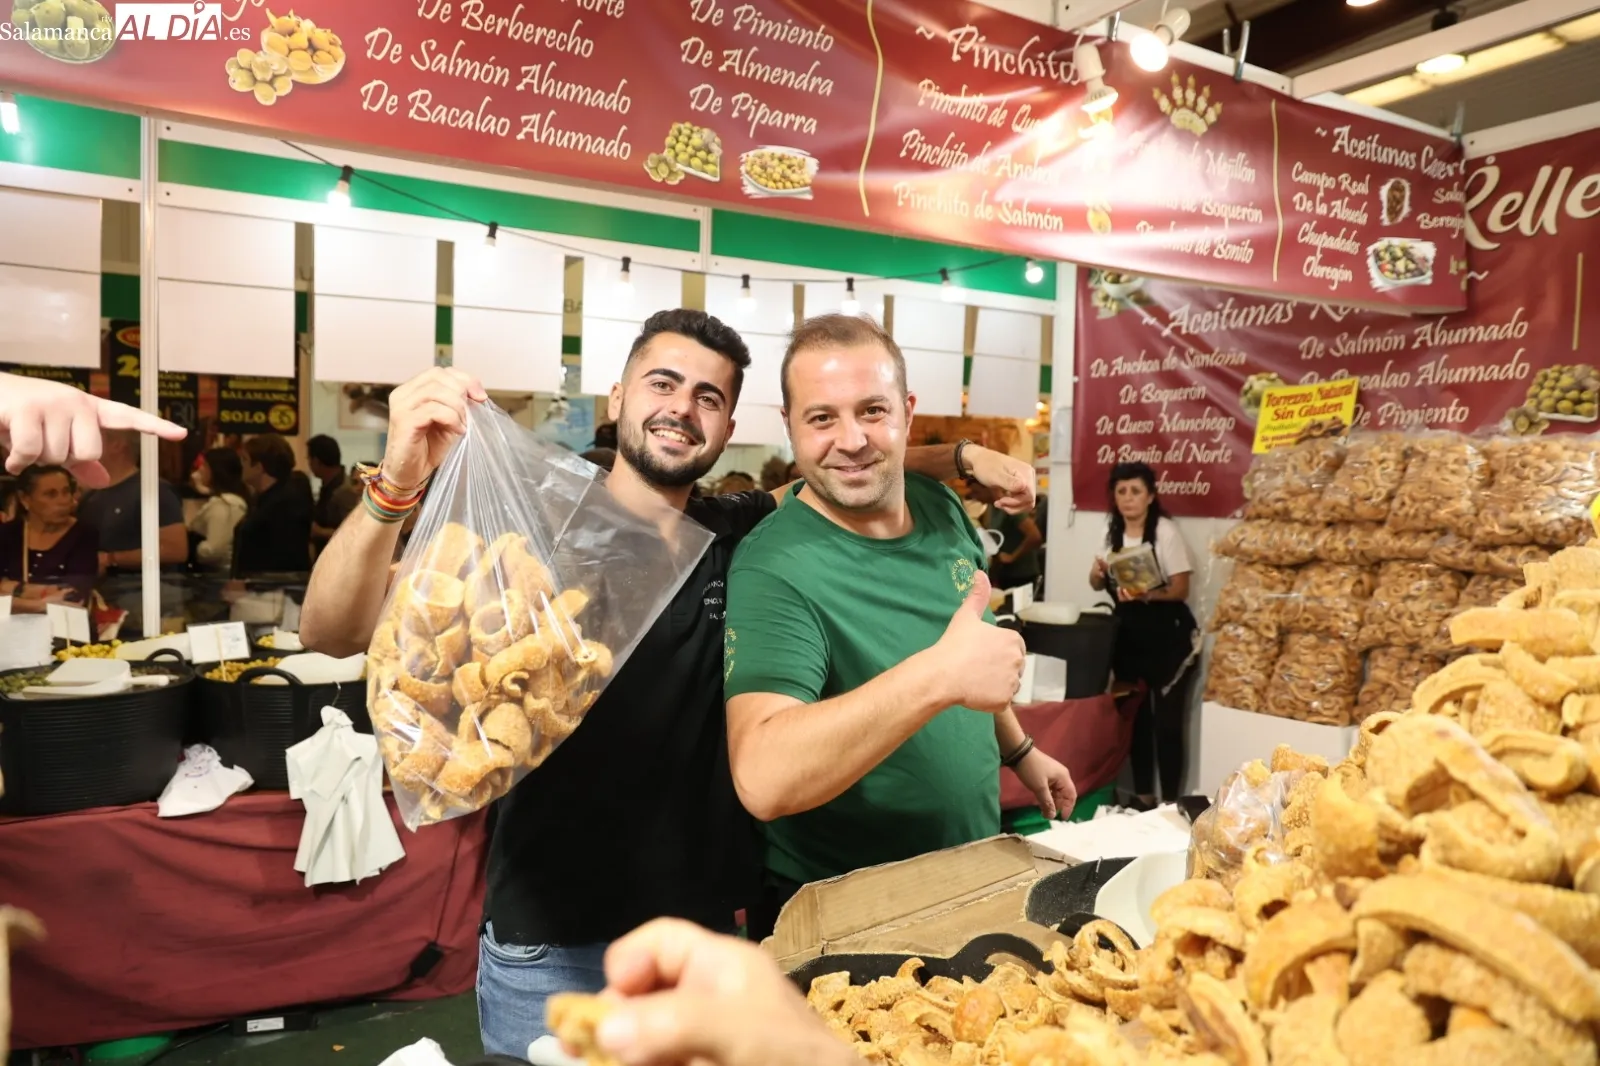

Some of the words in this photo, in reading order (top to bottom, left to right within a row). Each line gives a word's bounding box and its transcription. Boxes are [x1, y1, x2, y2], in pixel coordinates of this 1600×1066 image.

[577, 0, 626, 18] orte
[690, 0, 724, 26] De
[733, 4, 834, 52] Pimiento
[418, 0, 451, 23] De
[460, 0, 594, 58] Berberecho
[364, 27, 402, 64] De
[411, 39, 510, 87] Salmón
[516, 61, 631, 115] Ahumado
[680, 37, 713, 67] De
[718, 46, 834, 97] Almendra
[360, 79, 398, 115] De
[407, 88, 510, 137] Bacalao
[516, 110, 631, 161] Ahumado
[689, 83, 723, 115] De
[731, 92, 818, 138] Piparra
[918, 79, 987, 122] Pinchito
[987, 97, 1008, 127] de
[900, 128, 969, 169] Pinchito
[969, 141, 991, 175] de
[1332, 125, 1417, 170] Aceitunas
[1292, 161, 1336, 197] Campo
[1338, 173, 1370, 196] Real
[894, 182, 970, 217] Pinchito
[974, 191, 993, 222] de
[999, 198, 1063, 232] Salmón
[1202, 194, 1263, 230] Boquerón
[1293, 192, 1313, 213] De
[1316, 192, 1327, 216] la
[1329, 197, 1368, 226] Abuela
[1213, 234, 1254, 264] Bonito
[1297, 220, 1360, 256] Chupadedos
[1303, 254, 1353, 291] Obregón
[1161, 297, 1297, 337] Aceitunas
[1299, 336, 1325, 360] De
[1329, 325, 1406, 358] Salmón
[1411, 307, 1529, 349] Ahumado
[1090, 358, 1108, 378] De
[1109, 350, 1160, 377] Anchoa
[1162, 346, 1178, 371] de
[1415, 348, 1530, 387] Ahumado
[1119, 384, 1138, 405] De
[1140, 381, 1206, 412] Boquerón
[1265, 391, 1313, 408] Torrezno
[1316, 379, 1356, 400] Natural
[1272, 407, 1294, 421] Sin
[1298, 401, 1343, 418] Gluten
[1377, 397, 1469, 427] Pimiento
[221, 409, 267, 424] SOLO
[1096, 416, 1114, 435] De
[1116, 414, 1154, 435] Queso
[1158, 406, 1236, 443] Manchego
[1097, 445, 1115, 464] De
[1117, 444, 1162, 464] Bonito
[1164, 439, 1190, 463] del
[1187, 442, 1233, 464] Norte
